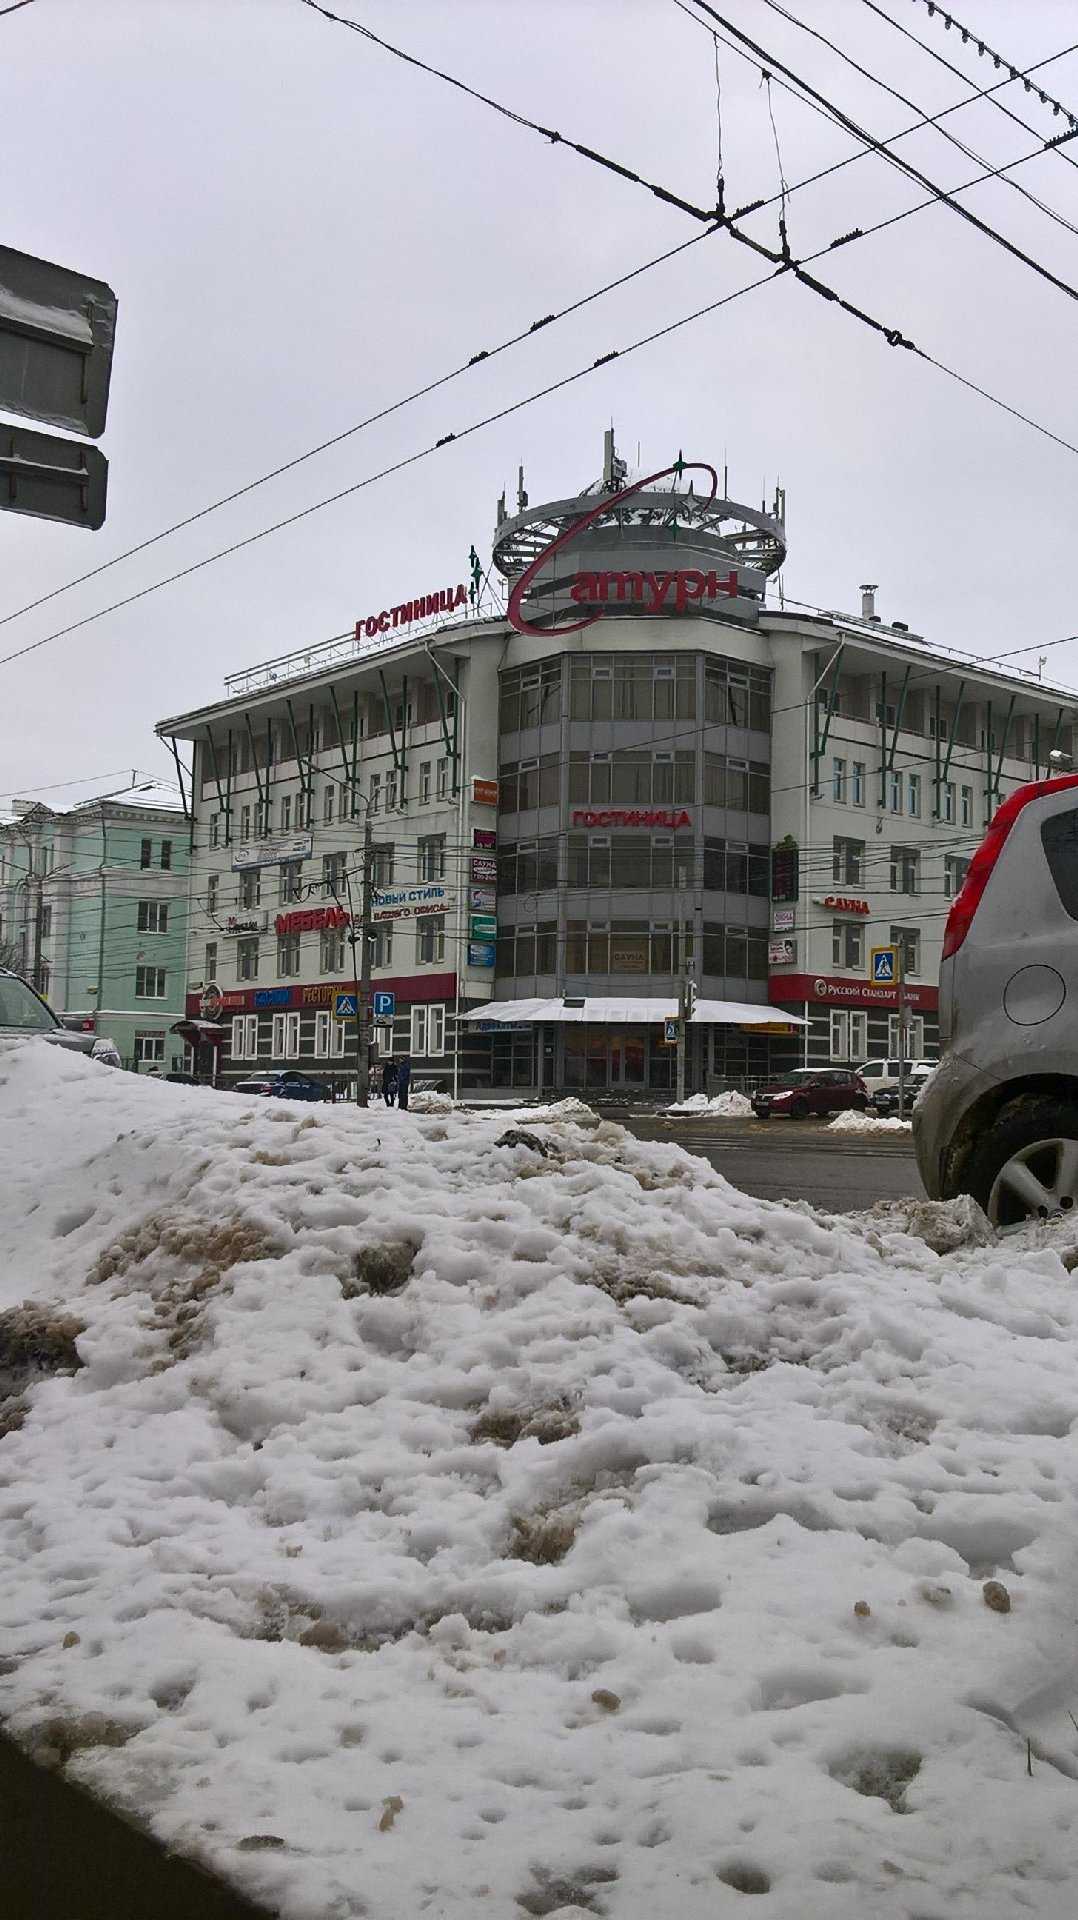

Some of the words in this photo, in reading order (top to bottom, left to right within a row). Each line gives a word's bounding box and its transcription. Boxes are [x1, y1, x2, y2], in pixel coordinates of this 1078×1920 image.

[353, 584, 468, 641] ГОСТИНИЦА
[572, 809, 692, 829] ГОСТИНИЦА
[409, 887, 445, 902] СТИЛЬ
[824, 896, 870, 915] САУНА
[275, 905, 350, 934] МЕБЕЛЬ
